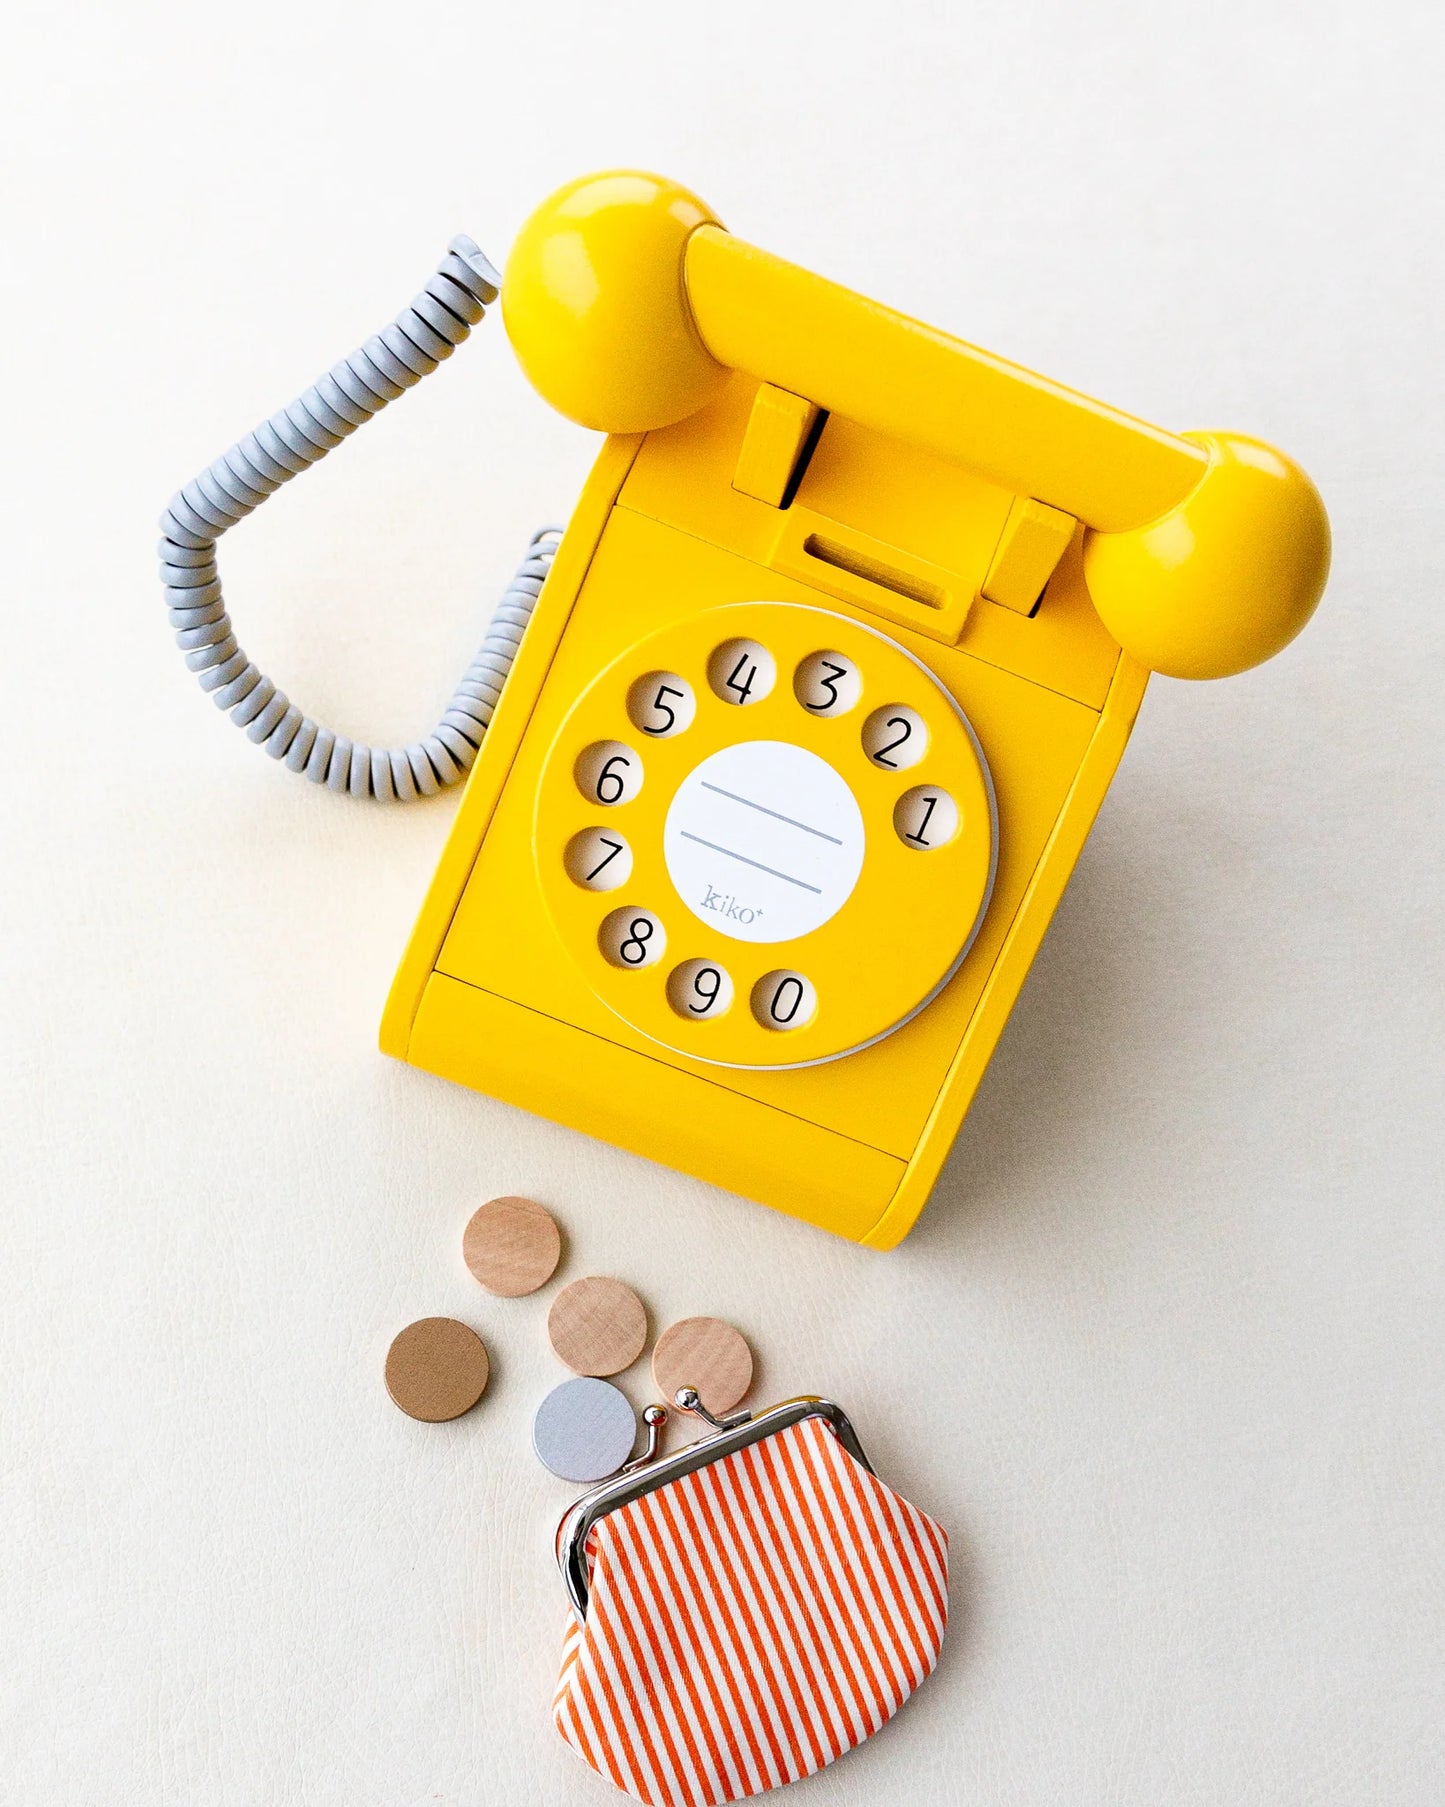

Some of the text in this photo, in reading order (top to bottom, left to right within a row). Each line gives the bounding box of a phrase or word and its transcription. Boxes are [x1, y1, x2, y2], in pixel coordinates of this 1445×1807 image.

[725, 653, 758, 704] 4
[803, 660, 847, 711] 3
[642, 684, 684, 735] 5
[872, 717, 912, 768] 2
[596, 756, 630, 805] 6
[903, 797, 937, 846] 1
[585, 837, 624, 882] 7
[619, 917, 654, 966] 8
[688, 967, 721, 1015] 9
[770, 977, 804, 1024] 0
